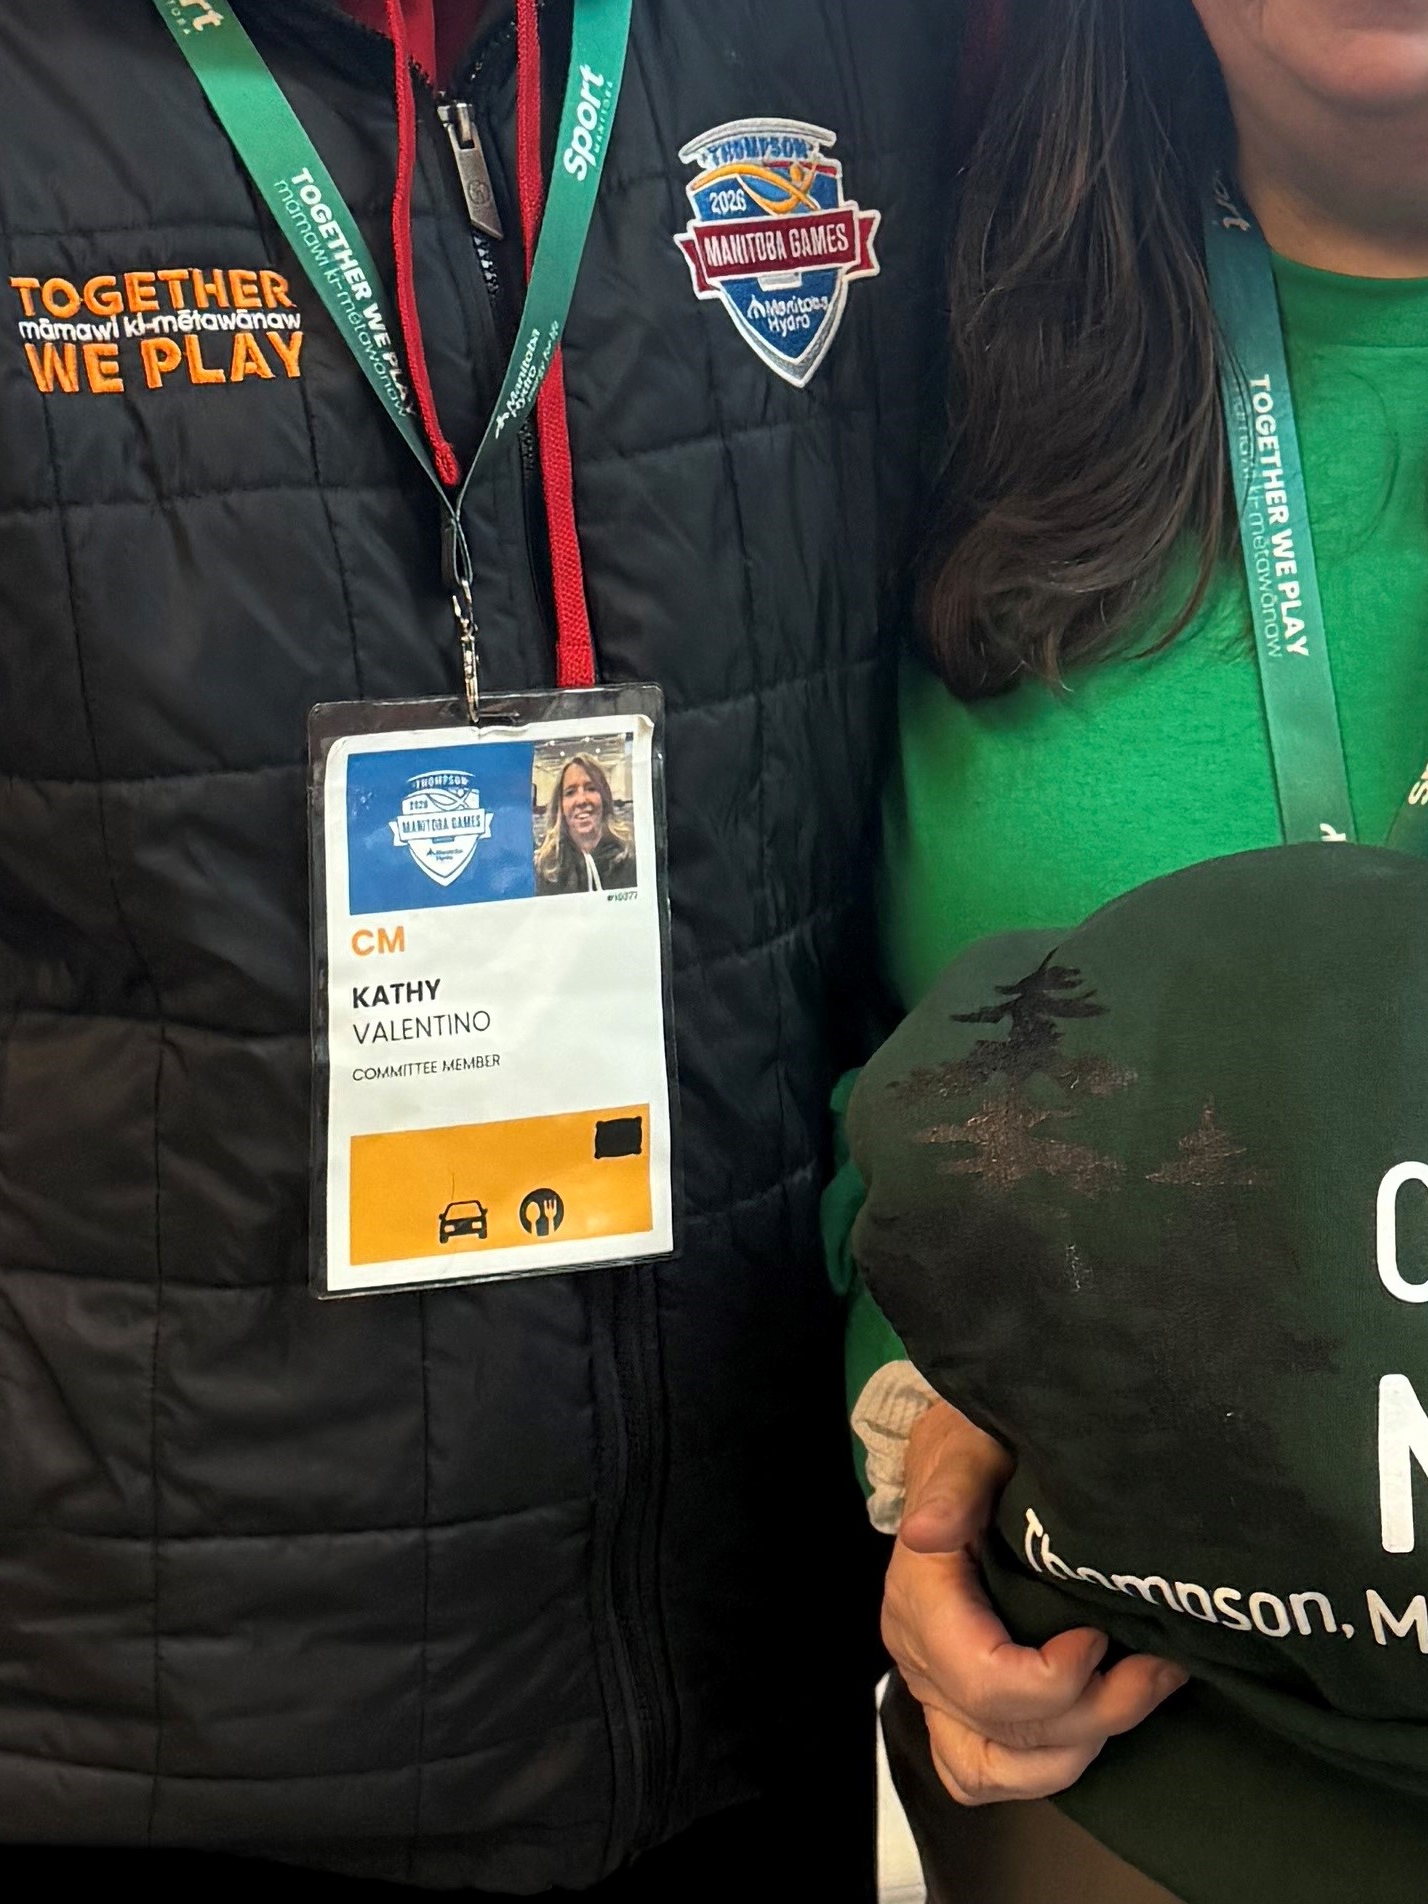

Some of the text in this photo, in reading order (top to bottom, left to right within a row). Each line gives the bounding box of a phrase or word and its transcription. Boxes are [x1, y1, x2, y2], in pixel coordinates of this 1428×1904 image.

[562, 63, 605, 182] Sport
[707, 135, 810, 167] THOMPSON
[709, 189, 747, 215] 2026
[703, 222, 849, 268] MANITOBA GAMES
[8, 267, 298, 319] TOGETHER
[290, 167, 418, 416] TOGETHER WE PLAY
[765, 294, 829, 319] Manitoba
[768, 312, 811, 338] Hydro
[24, 330, 304, 394] WE PLAY
[506, 327, 541, 412] Manitoba
[1249, 373, 1310, 657] TOGETHER WE PLAY
[415, 775, 469, 790] THOMPSON
[401, 814, 481, 834] MANITOBA GAMES
[351, 925, 405, 957] CM
[352, 978, 441, 1009] KATHY
[352, 1010, 491, 1045] VALENTINO
[352, 1053, 501, 1081] COMMITTEE MEMBER
